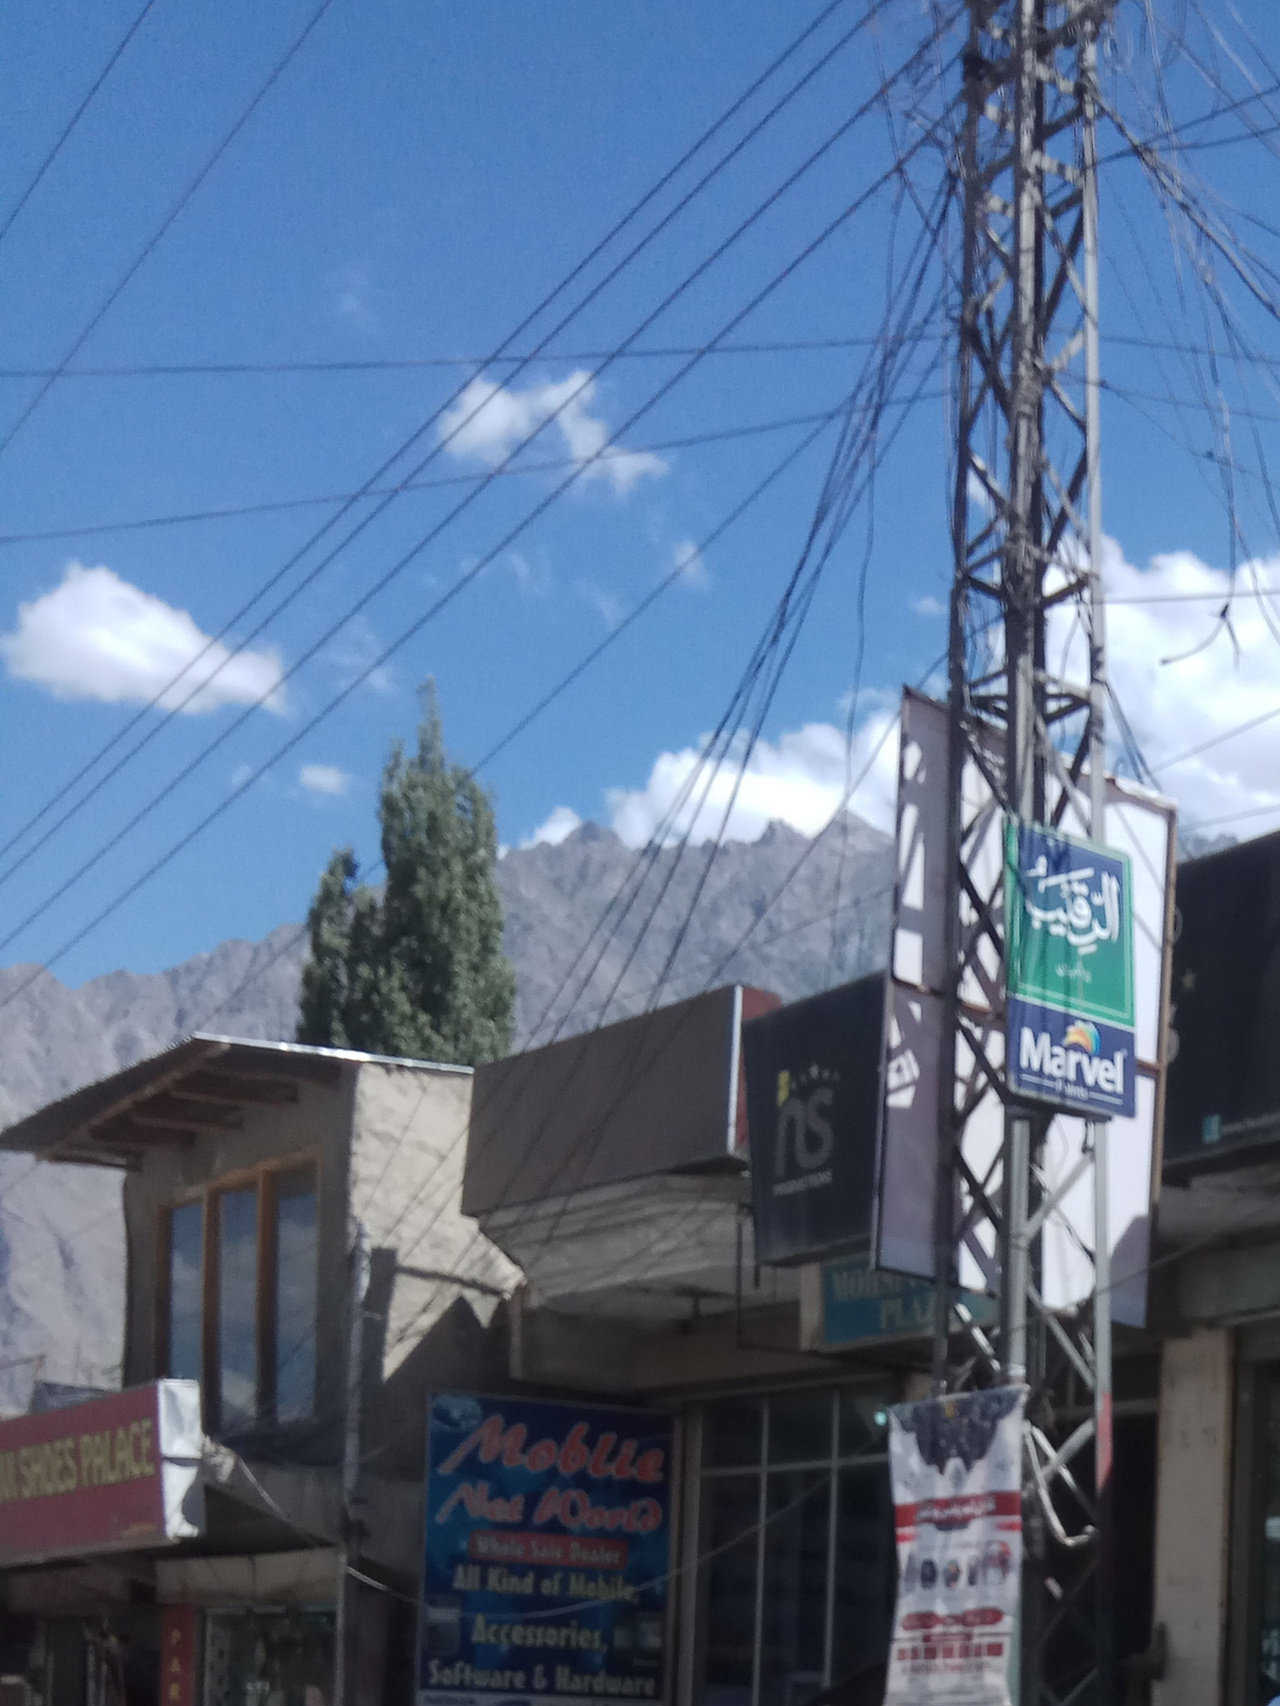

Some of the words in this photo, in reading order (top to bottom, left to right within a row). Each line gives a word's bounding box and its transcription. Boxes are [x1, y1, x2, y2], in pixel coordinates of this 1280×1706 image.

[1019, 1025, 1125, 1095] Marvel
[79, 1416, 155, 1489] PALACE
[452, 1563, 483, 1591] All
[487, 1565, 535, 1595] Kind
[540, 1571, 563, 1597] of
[427, 1657, 527, 1691] Software
[532, 1662, 549, 1691] &
[555, 1662, 656, 1698] Hardware
